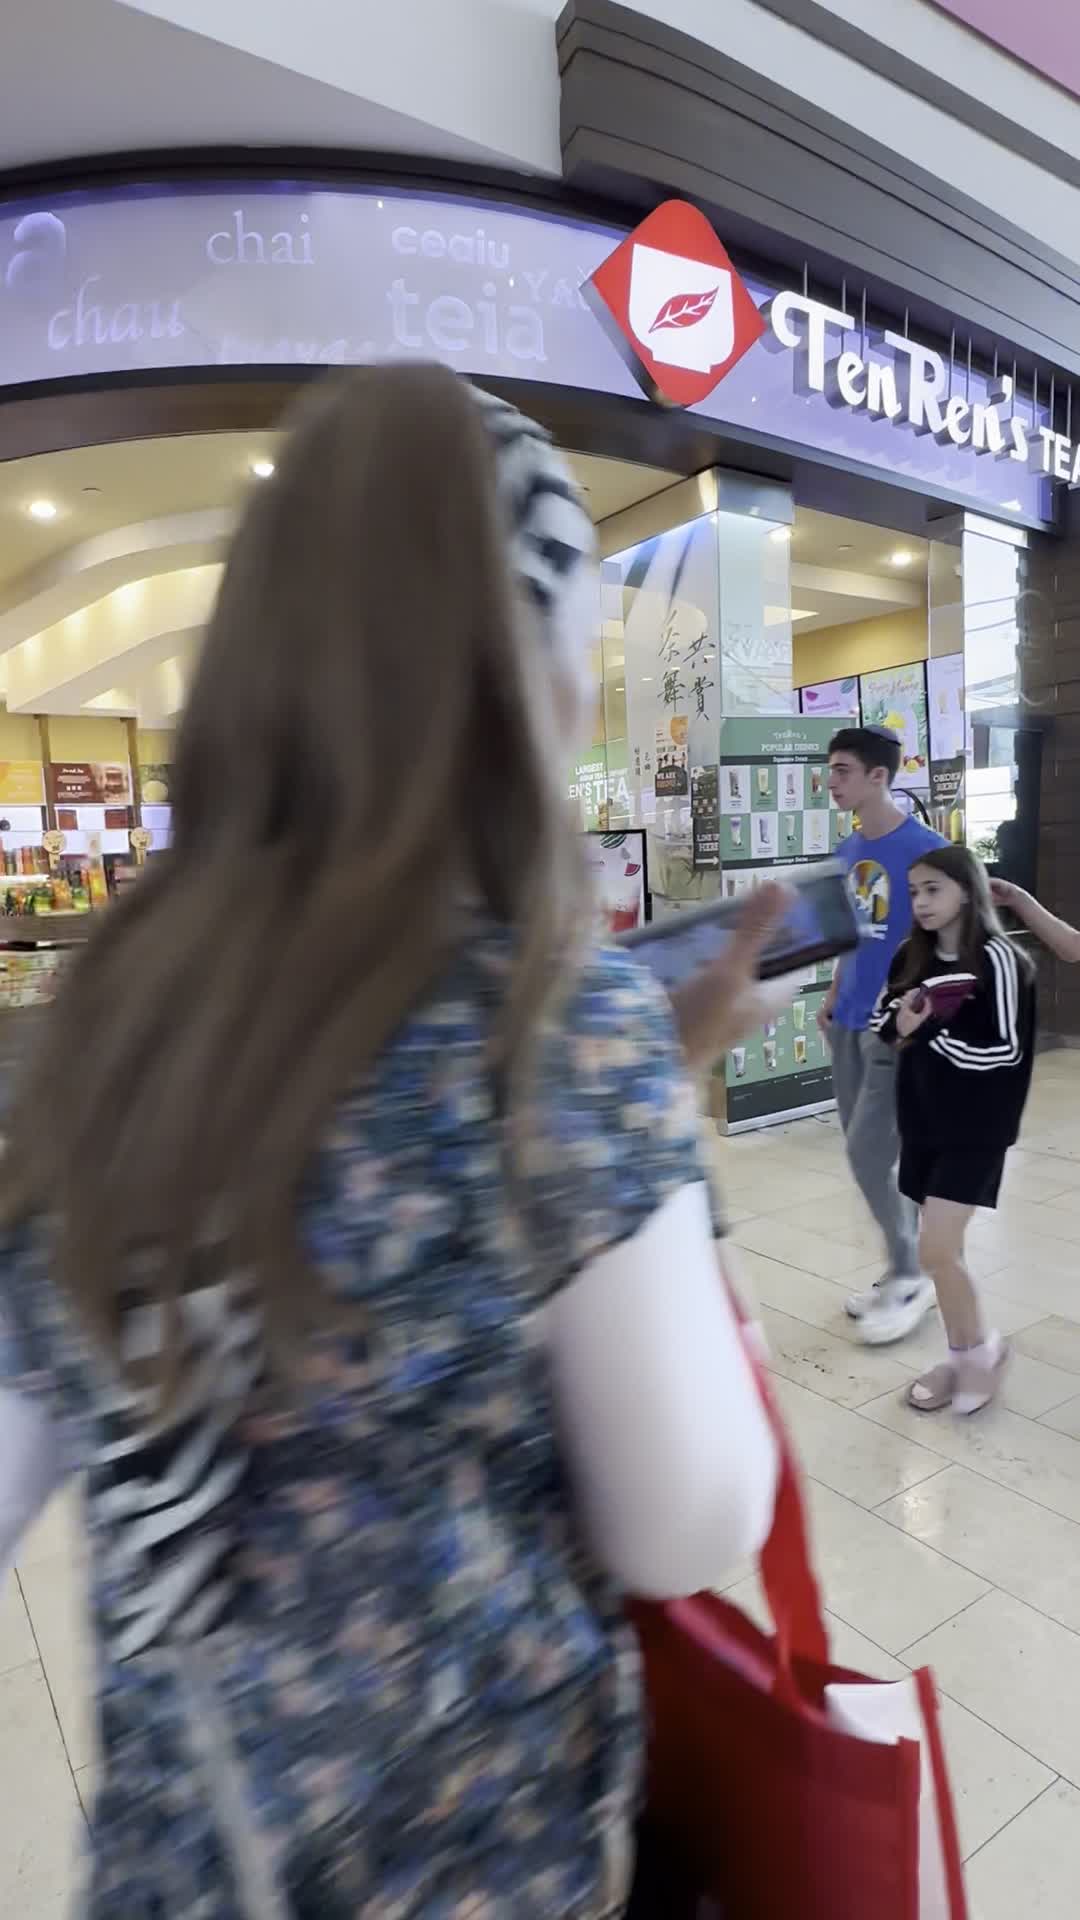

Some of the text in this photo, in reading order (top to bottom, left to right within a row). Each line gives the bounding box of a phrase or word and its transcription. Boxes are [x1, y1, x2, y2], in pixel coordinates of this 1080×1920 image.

[205, 209, 315, 265] chai
[391, 224, 510, 268] ceaiu
[386, 276, 549, 363] teia
[761, 744, 793, 752] POPULAR
